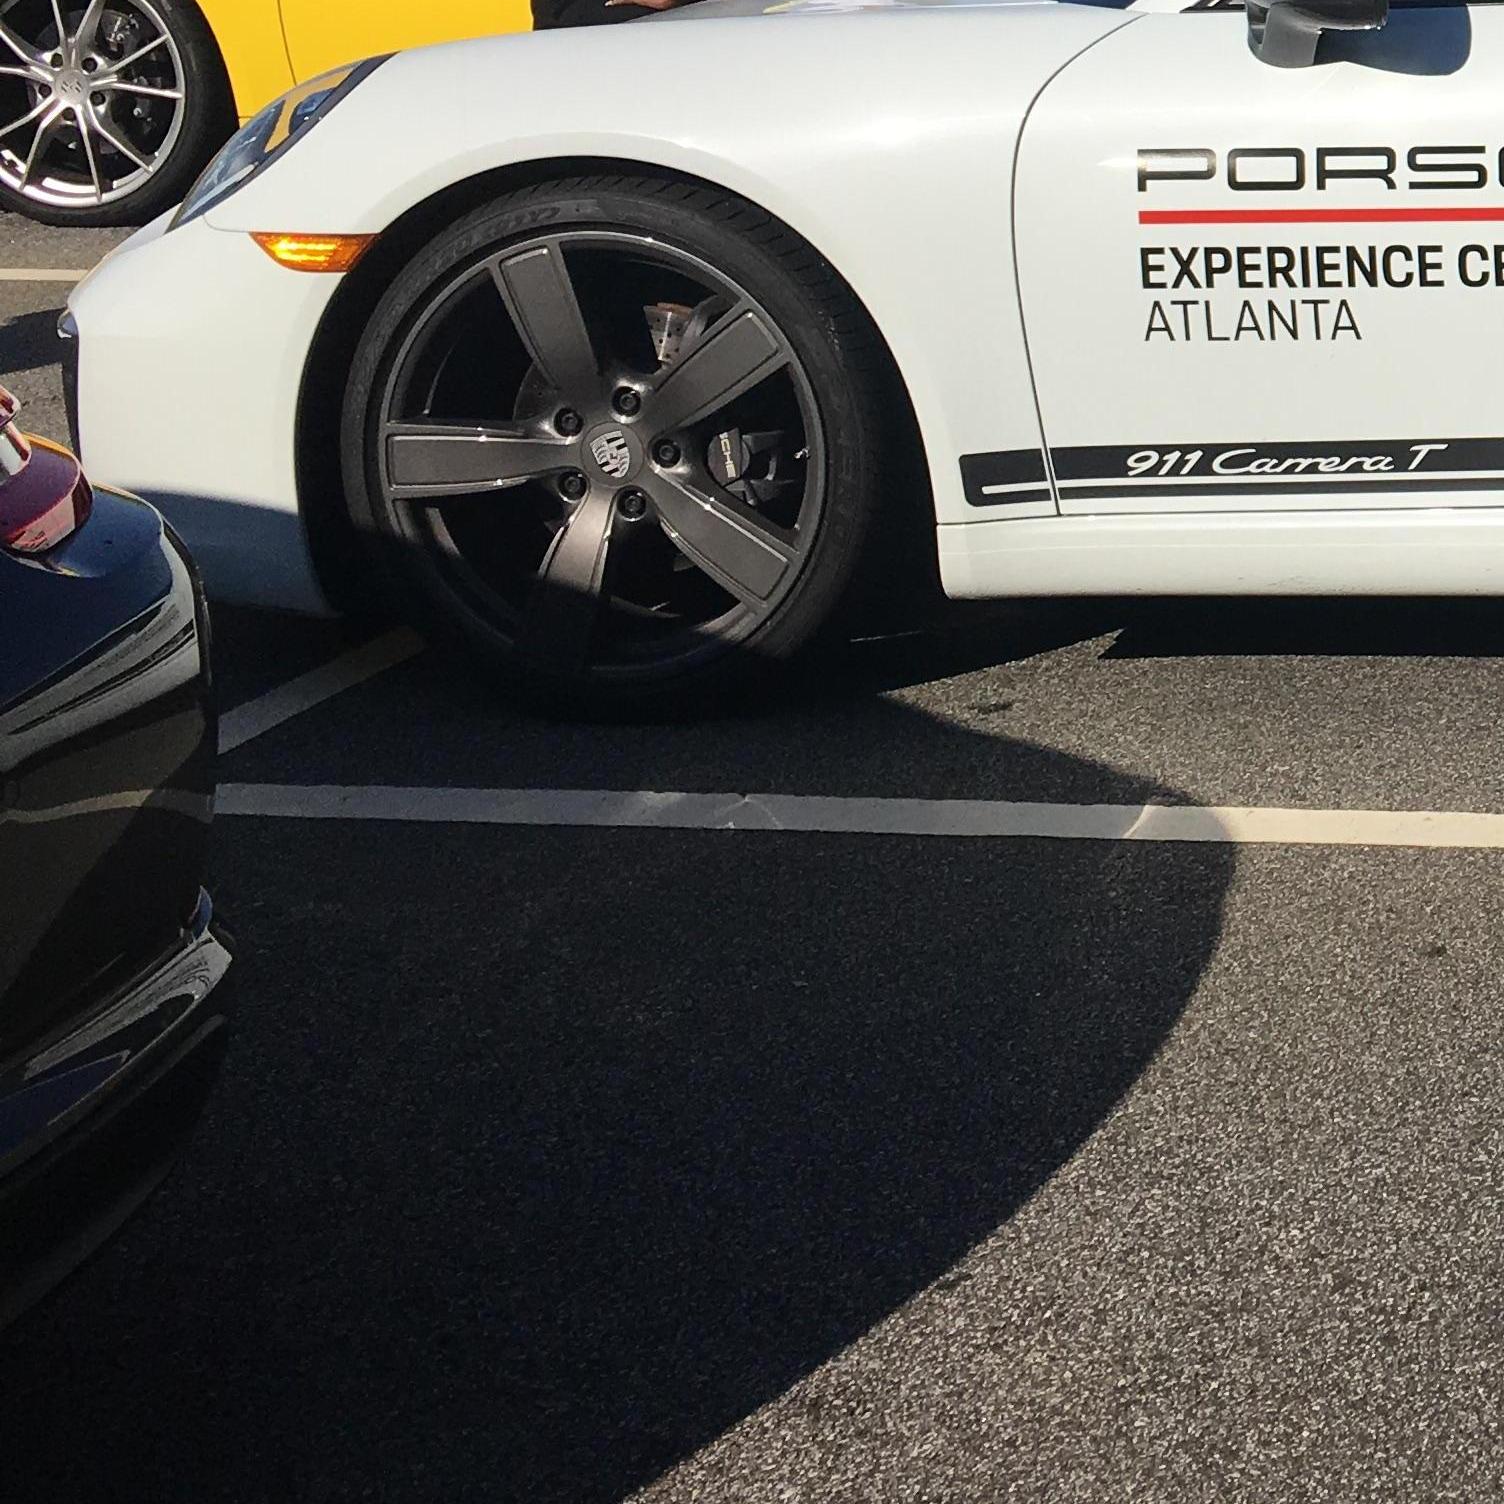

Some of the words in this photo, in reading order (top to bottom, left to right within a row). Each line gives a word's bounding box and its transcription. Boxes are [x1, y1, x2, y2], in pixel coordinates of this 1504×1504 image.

[1139, 244, 1445, 290] EXPERIENCE
[1143, 299, 1363, 342] ATLANTA
[1126, 450, 1204, 477] 911
[1211, 448, 1395, 475] Carrera
[1407, 443, 1449, 471] T
